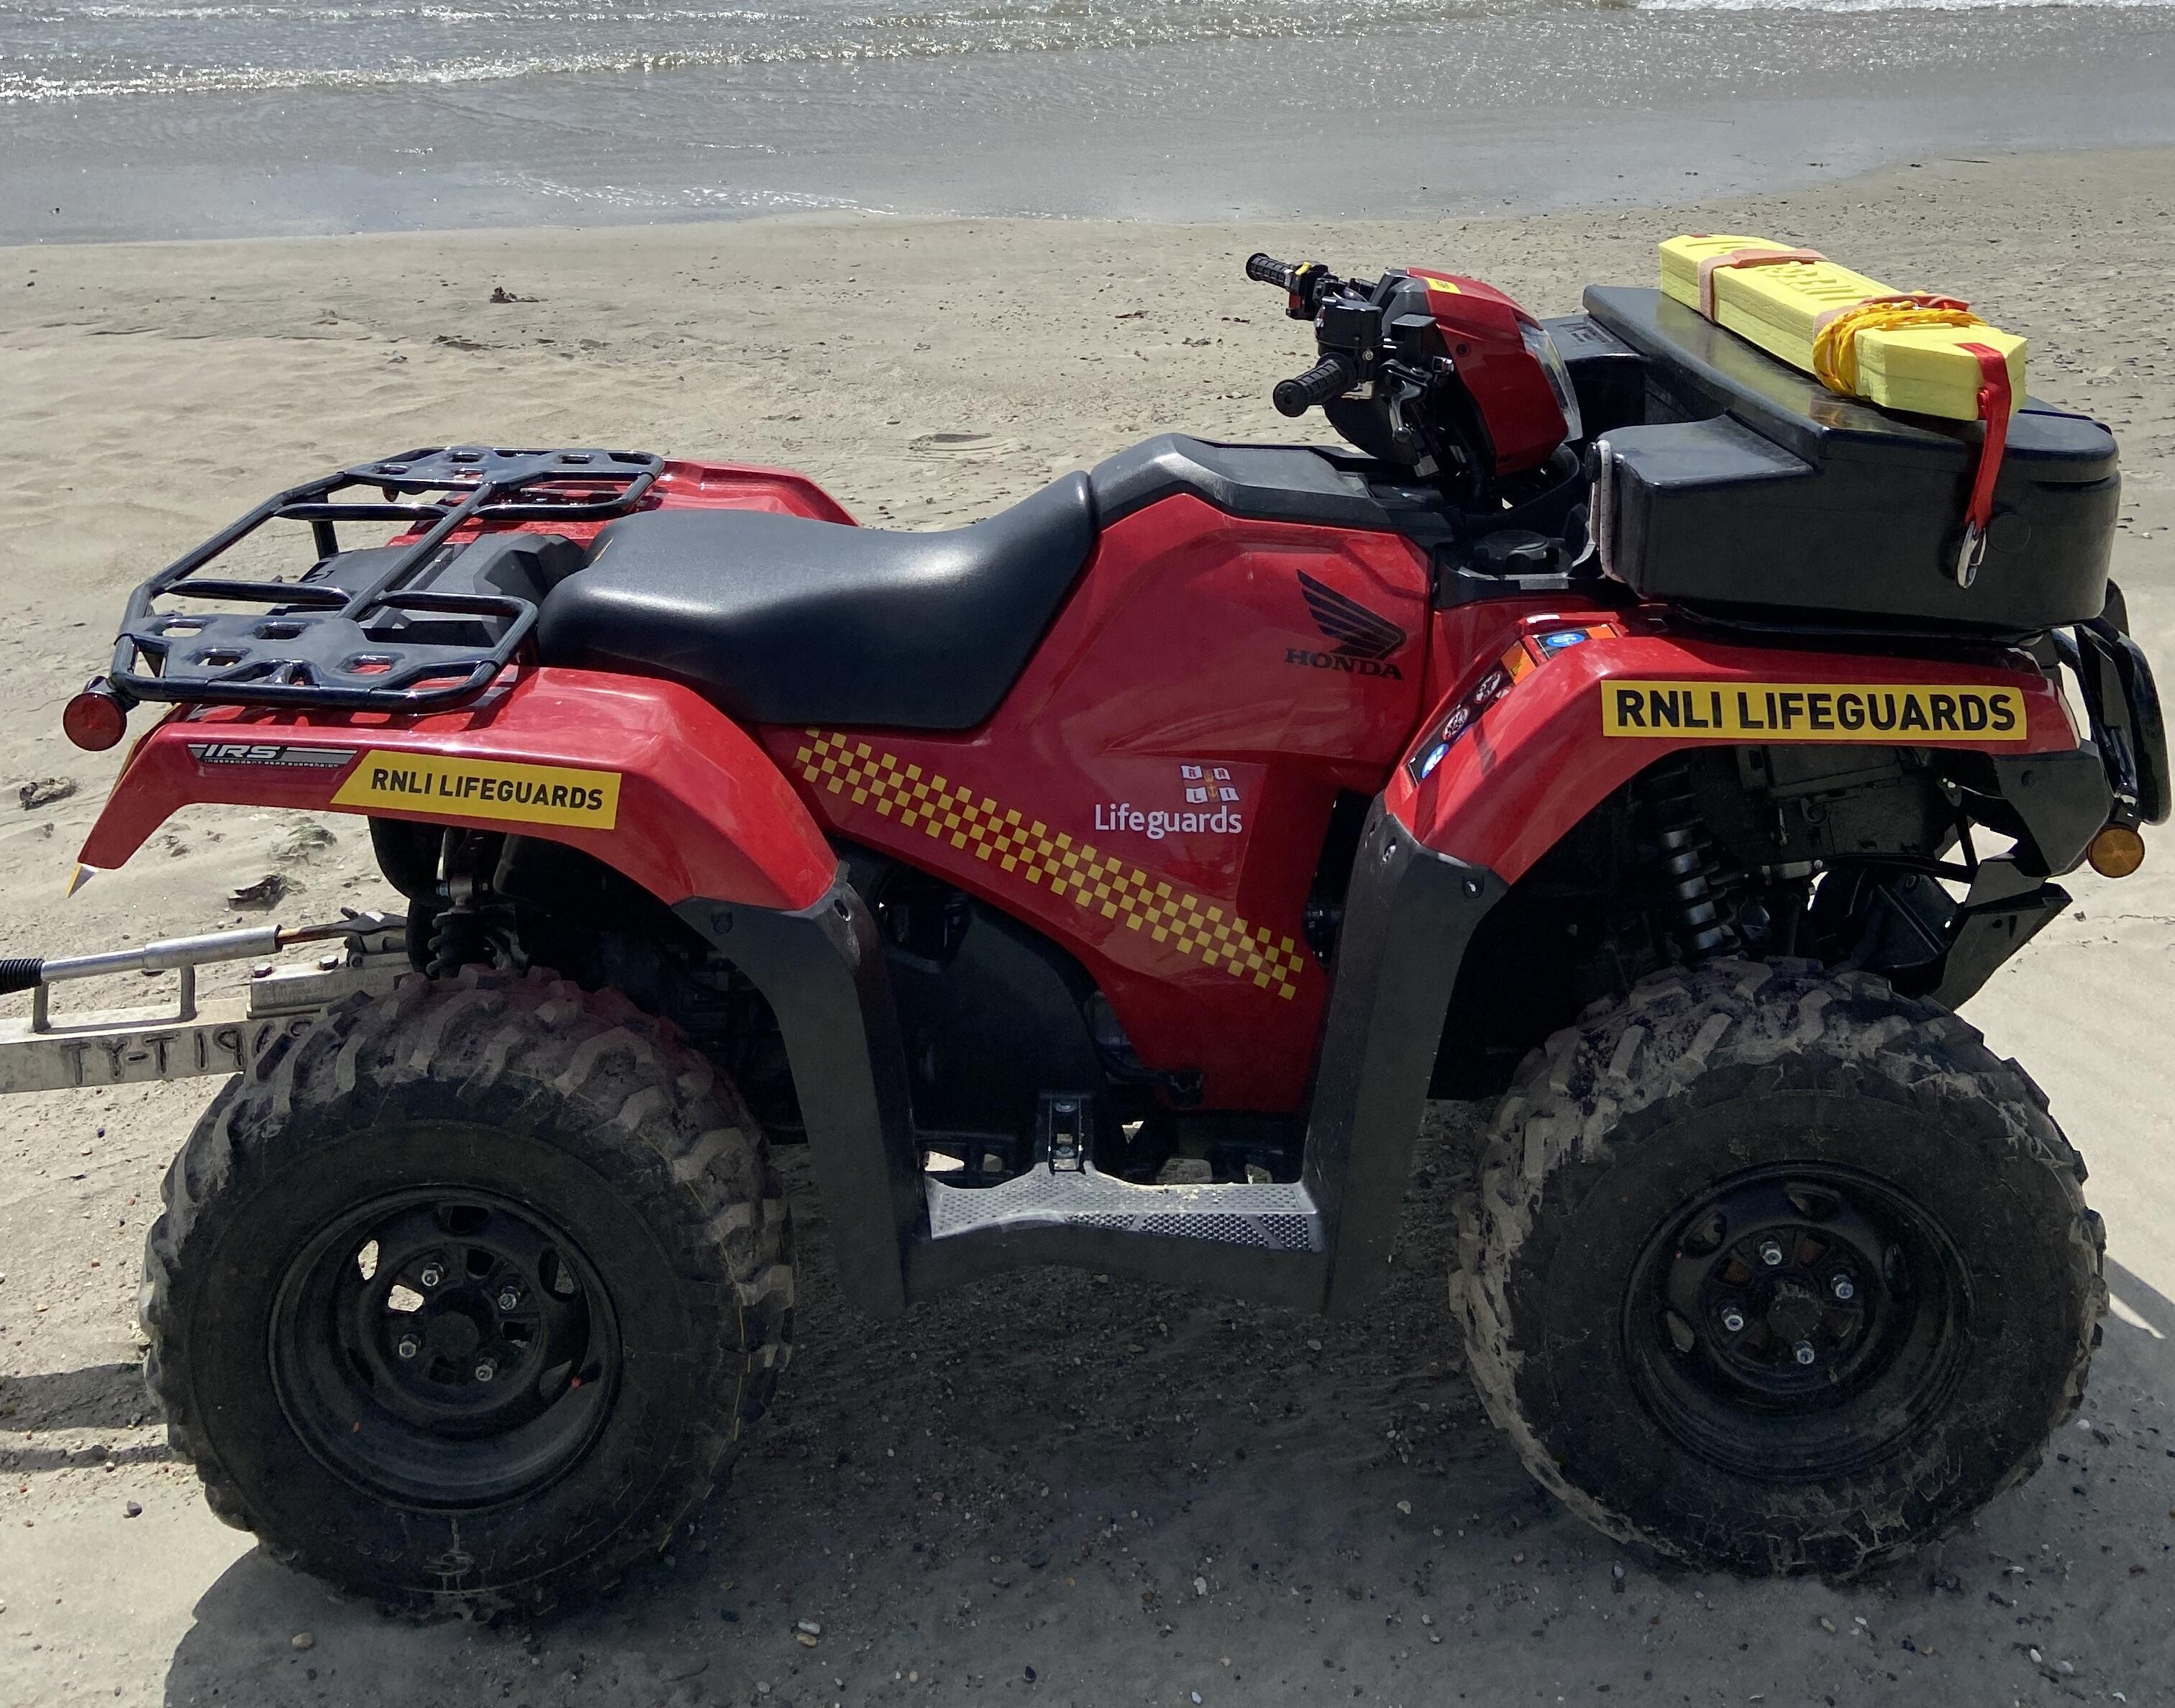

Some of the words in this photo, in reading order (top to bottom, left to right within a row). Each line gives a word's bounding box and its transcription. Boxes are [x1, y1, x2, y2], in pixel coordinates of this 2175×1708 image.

[1285, 648, 1403, 680] HONDA
[1616, 689, 1721, 728] RNLI
[1738, 692, 2015, 731] LIFEGUARDS
[205, 744, 281, 759] IRS
[371, 768, 432, 795] RNLI
[439, 775, 603, 810] LIFEGUARDS
[1095, 803, 1242, 839] Lifeguards
